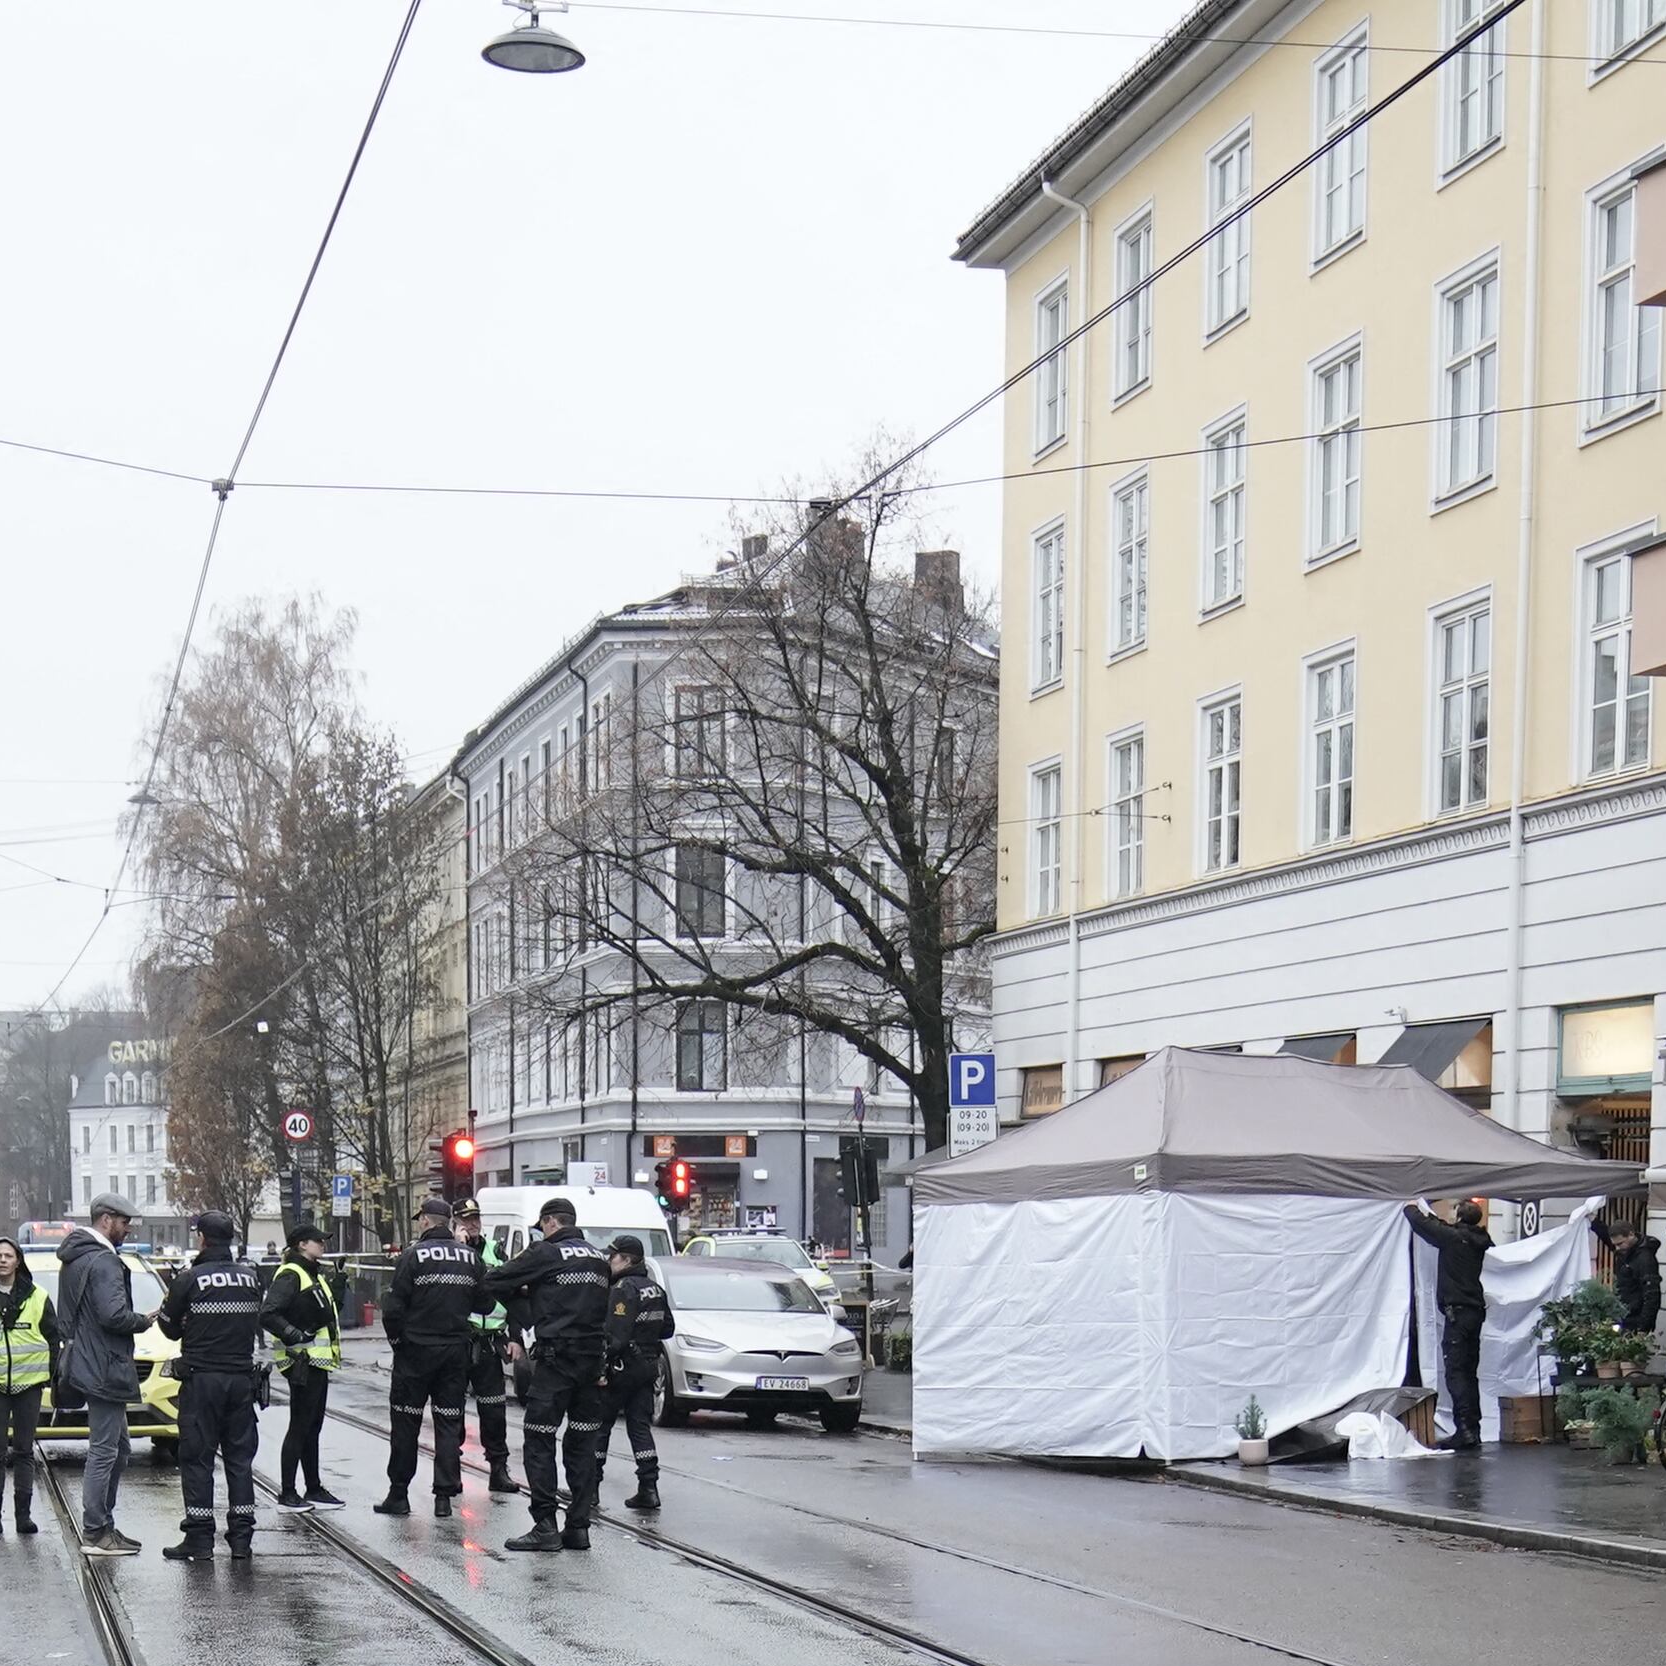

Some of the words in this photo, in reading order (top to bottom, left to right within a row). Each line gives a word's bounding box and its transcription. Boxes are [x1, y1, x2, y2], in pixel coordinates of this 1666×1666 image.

[960, 1060, 985, 1100] P
[288, 1118, 308, 1133] 40
[594, 1171, 606, 1181] 24
[337, 1178, 348, 1194] P
[417, 1246, 476, 1265] POLITI
[197, 1272, 258, 1291] POLITI
[764, 1379, 775, 1389] EV
